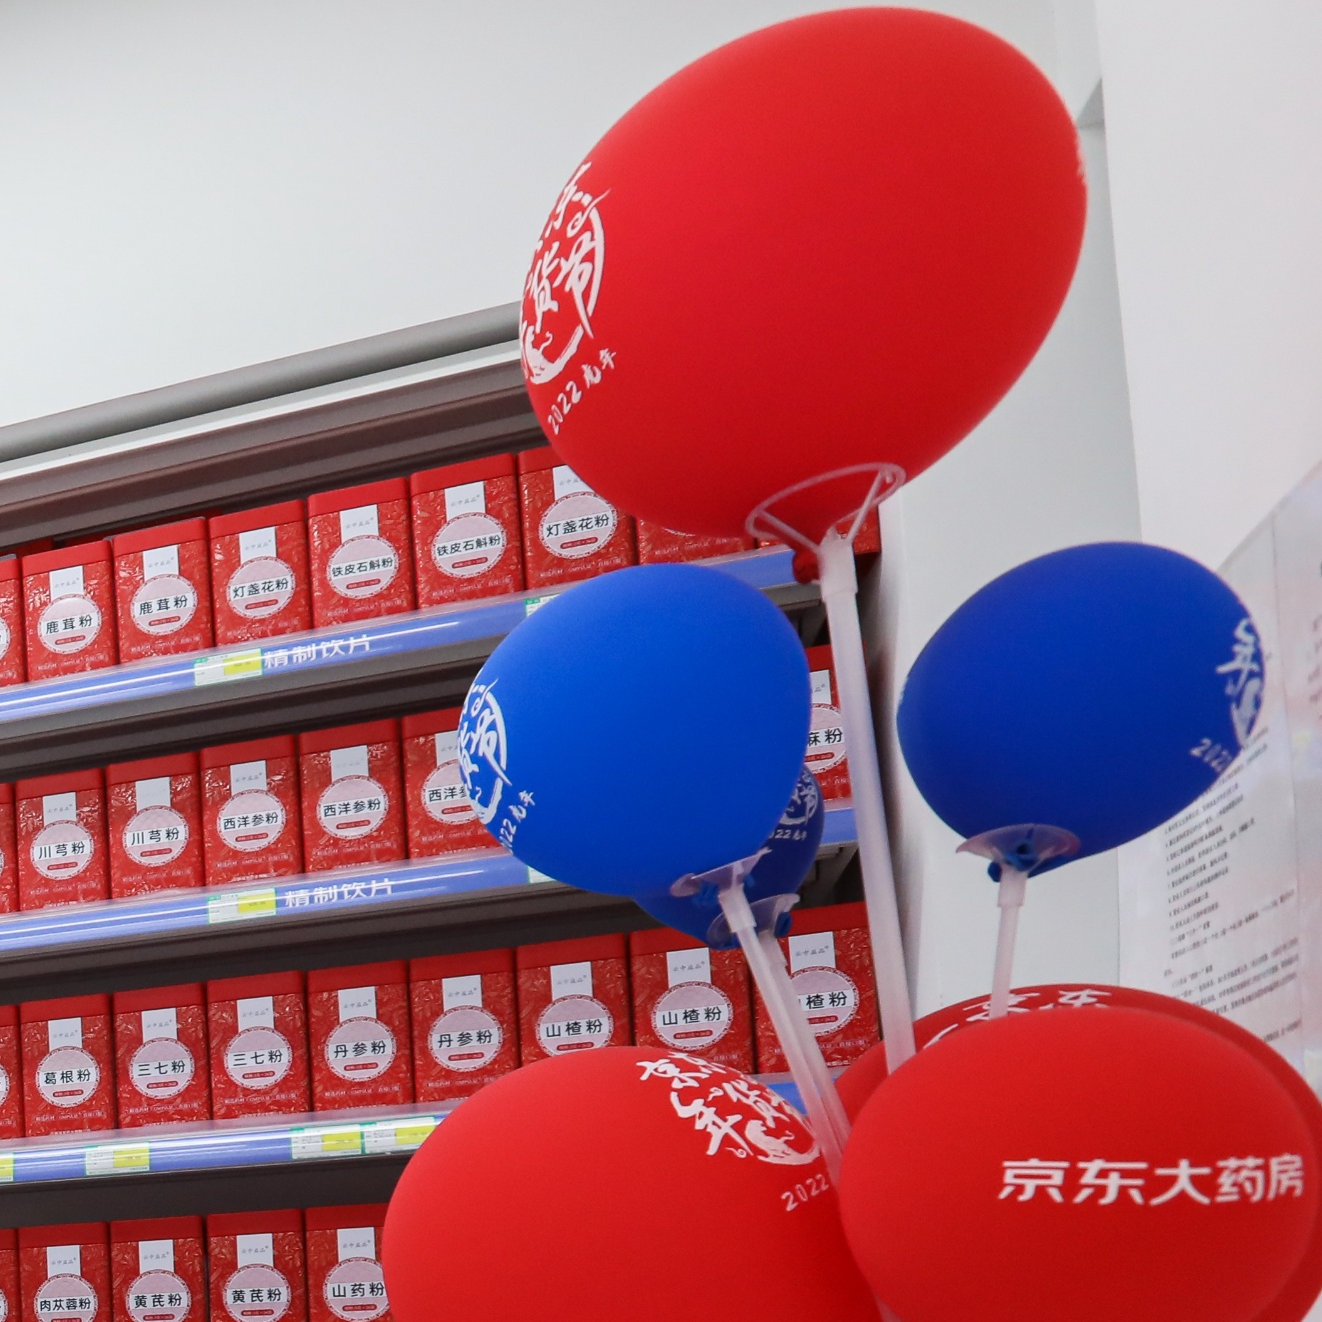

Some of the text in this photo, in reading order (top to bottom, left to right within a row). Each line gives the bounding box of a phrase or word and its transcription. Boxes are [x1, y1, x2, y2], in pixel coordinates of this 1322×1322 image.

[545, 513, 611, 539] 灯盏花粉
[232, 577, 289, 600] 灯盏花粉
[138, 595, 189, 615] 鹿茸粉
[45, 614, 93, 634] 鹿茸粉
[264, 634, 371, 670] 精制饮片
[323, 798, 382, 817] 西洋参粉
[223, 812, 279, 831] 西洋参粉
[130, 828, 180, 846] 川芎粉
[38, 841, 85, 860] 川芎粉
[284, 877, 395, 908] 精制饮片
[798, 991, 848, 1010] 楂粉
[662, 1006, 723, 1026] 山楂粉
[545, 1020, 603, 1038] 山楂粉
[437, 1030, 493, 1049] 丹参粉
[233, 1049, 283, 1067] 三七粉
[333, 1040, 387, 1059] 丹参粉
[43, 1068, 92, 1086] 葛根粉
[137, 1060, 187, 1077] 三七粉
[997, 1152, 1306, 1206] 京东大药房
[331, 1282, 385, 1299] 山药粉
